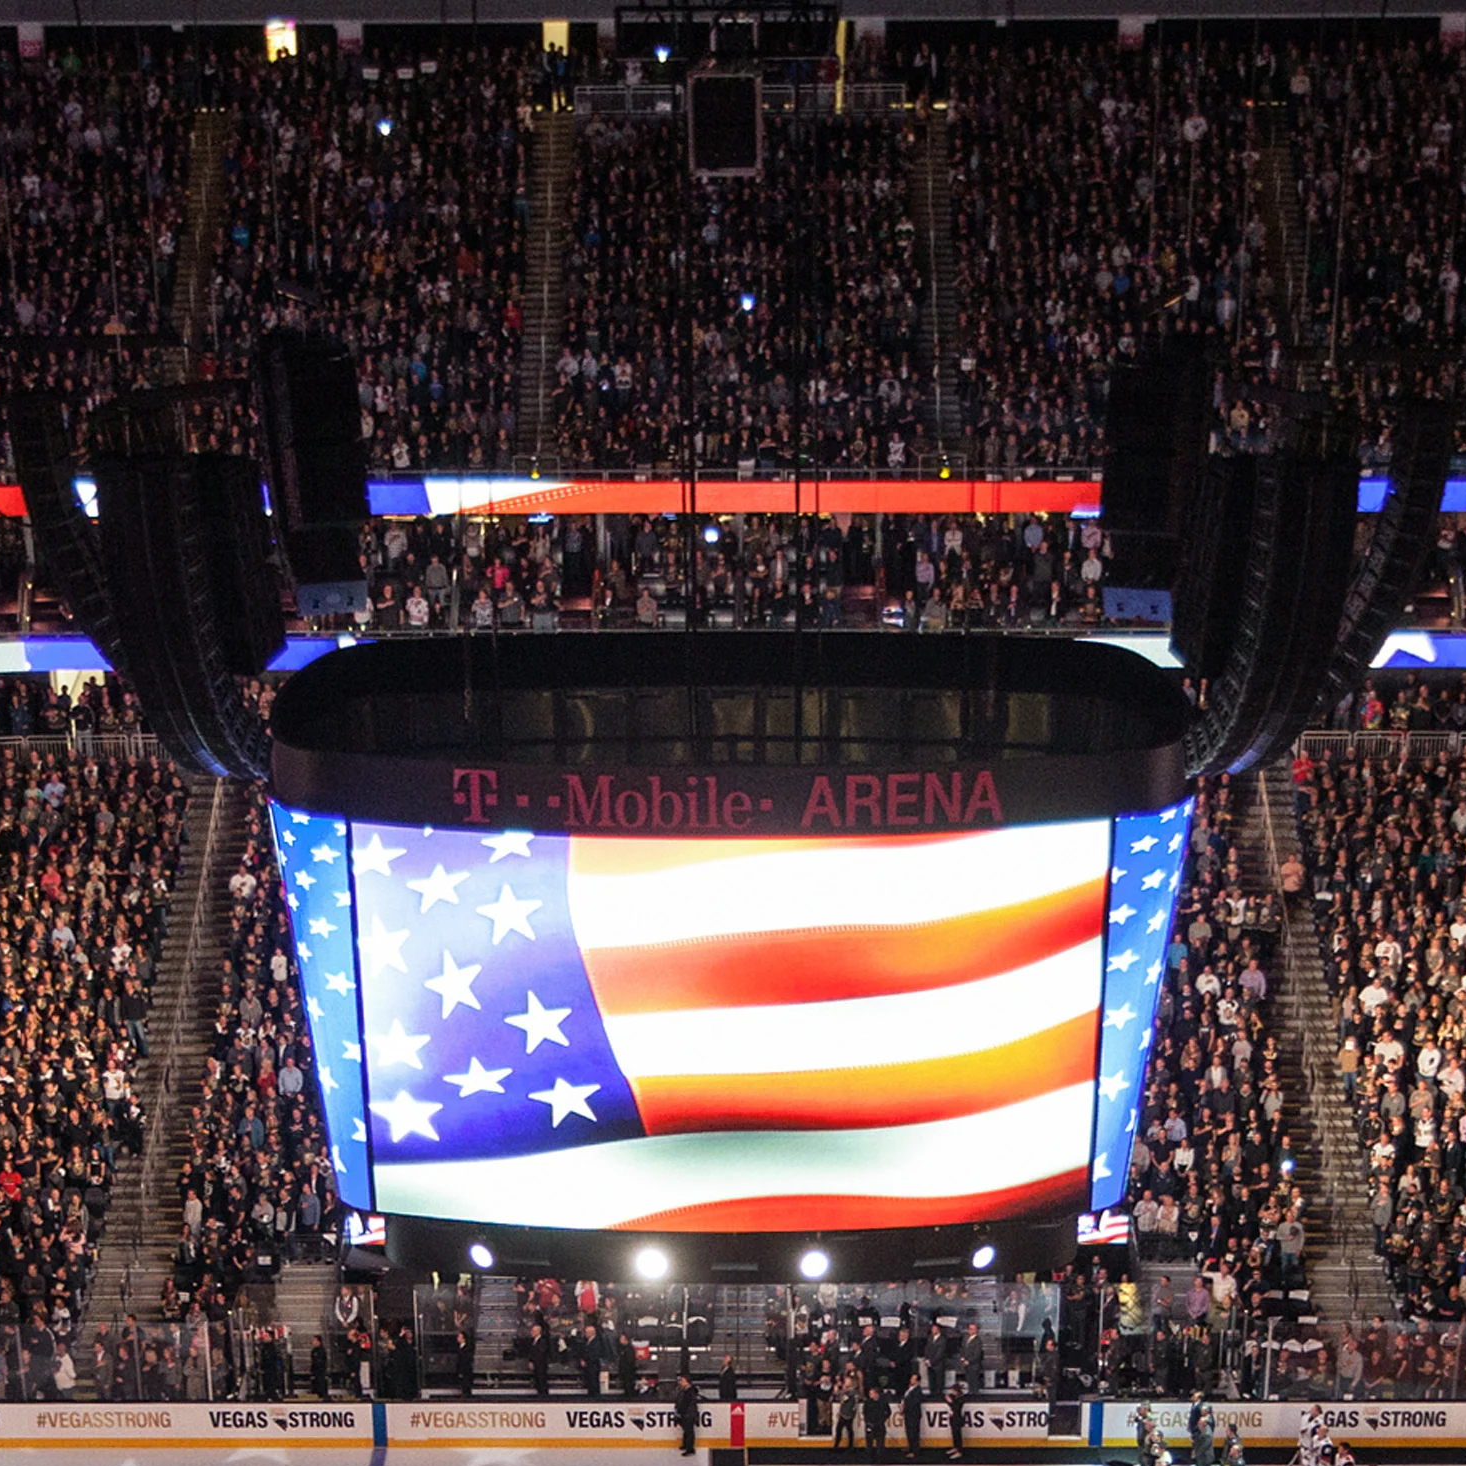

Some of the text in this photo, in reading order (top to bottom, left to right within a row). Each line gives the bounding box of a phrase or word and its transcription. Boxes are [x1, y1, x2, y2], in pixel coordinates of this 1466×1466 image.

[800, 771, 1005, 828] ARENA
[36, 1411, 172, 1429] #VEGASSTRONG
[209, 1411, 355, 1429] VEGAS STRONG
[410, 1411, 546, 1429] #VEGASSTRONG
[566, 1411, 625, 1429] VEGAS
[926, 1411, 1048, 1428] VEAS STRO
[1380, 1410, 1446, 1428] STRONG
